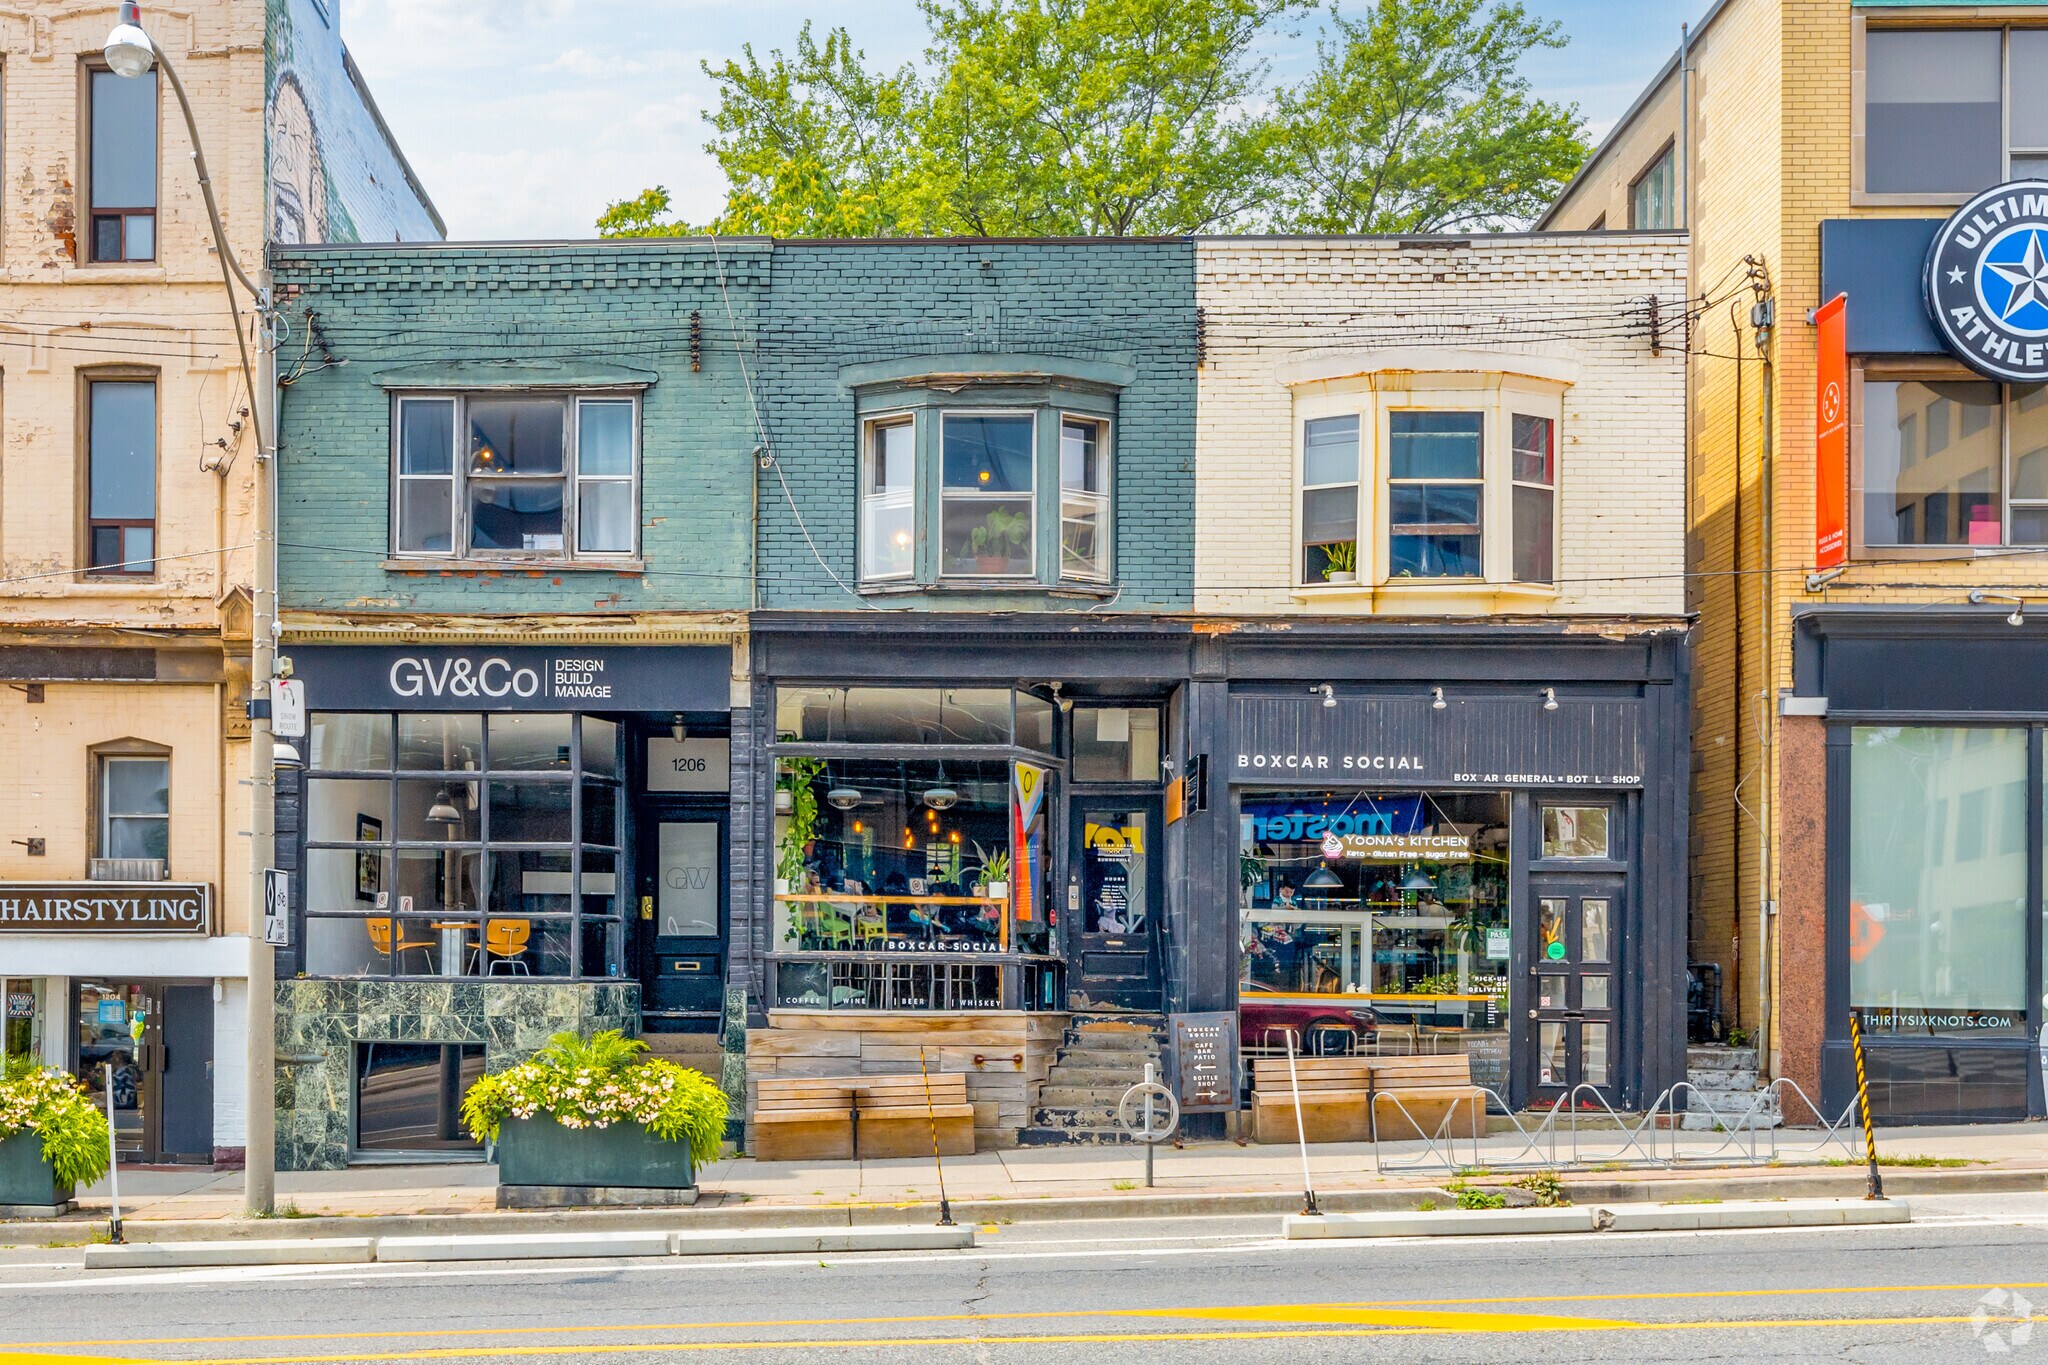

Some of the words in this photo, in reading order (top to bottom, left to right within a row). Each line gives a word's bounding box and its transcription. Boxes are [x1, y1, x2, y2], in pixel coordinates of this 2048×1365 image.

[1950, 306, 2048, 367] ATHLE
[555, 659, 604, 672] DESIGN
[390, 658, 539, 697] GV&Co
[555, 672, 593, 684] BUILD
[555, 685, 612, 698] MANAGE
[280, 712, 297, 720] SNOW
[279, 722, 298, 731] ROUTE
[671, 758, 706, 772] 1206
[1238, 755, 1328, 768] BOXCAR
[1343, 756, 1424, 769] SOCIAL
[1504, 774, 1555, 783] GENERAL
[1612, 775, 1641, 784] SHOP
[1410, 837, 1469, 847] KITCHEN
[1373, 850, 1397, 858] Gluten
[1399, 850, 1417, 858] Free
[1425, 851, 1448, 859] Sugar
[0, 899, 199, 921] HAIRSTYLING
[276, 931, 285, 942] LANE
[888, 941, 945, 950] BOXCAR
[953, 942, 1005, 951] SOCIAL
[960, 999, 1001, 1007] WHISKEY
[1863, 1015, 2012, 1028] THIRTYSIXKNOTS.COM
